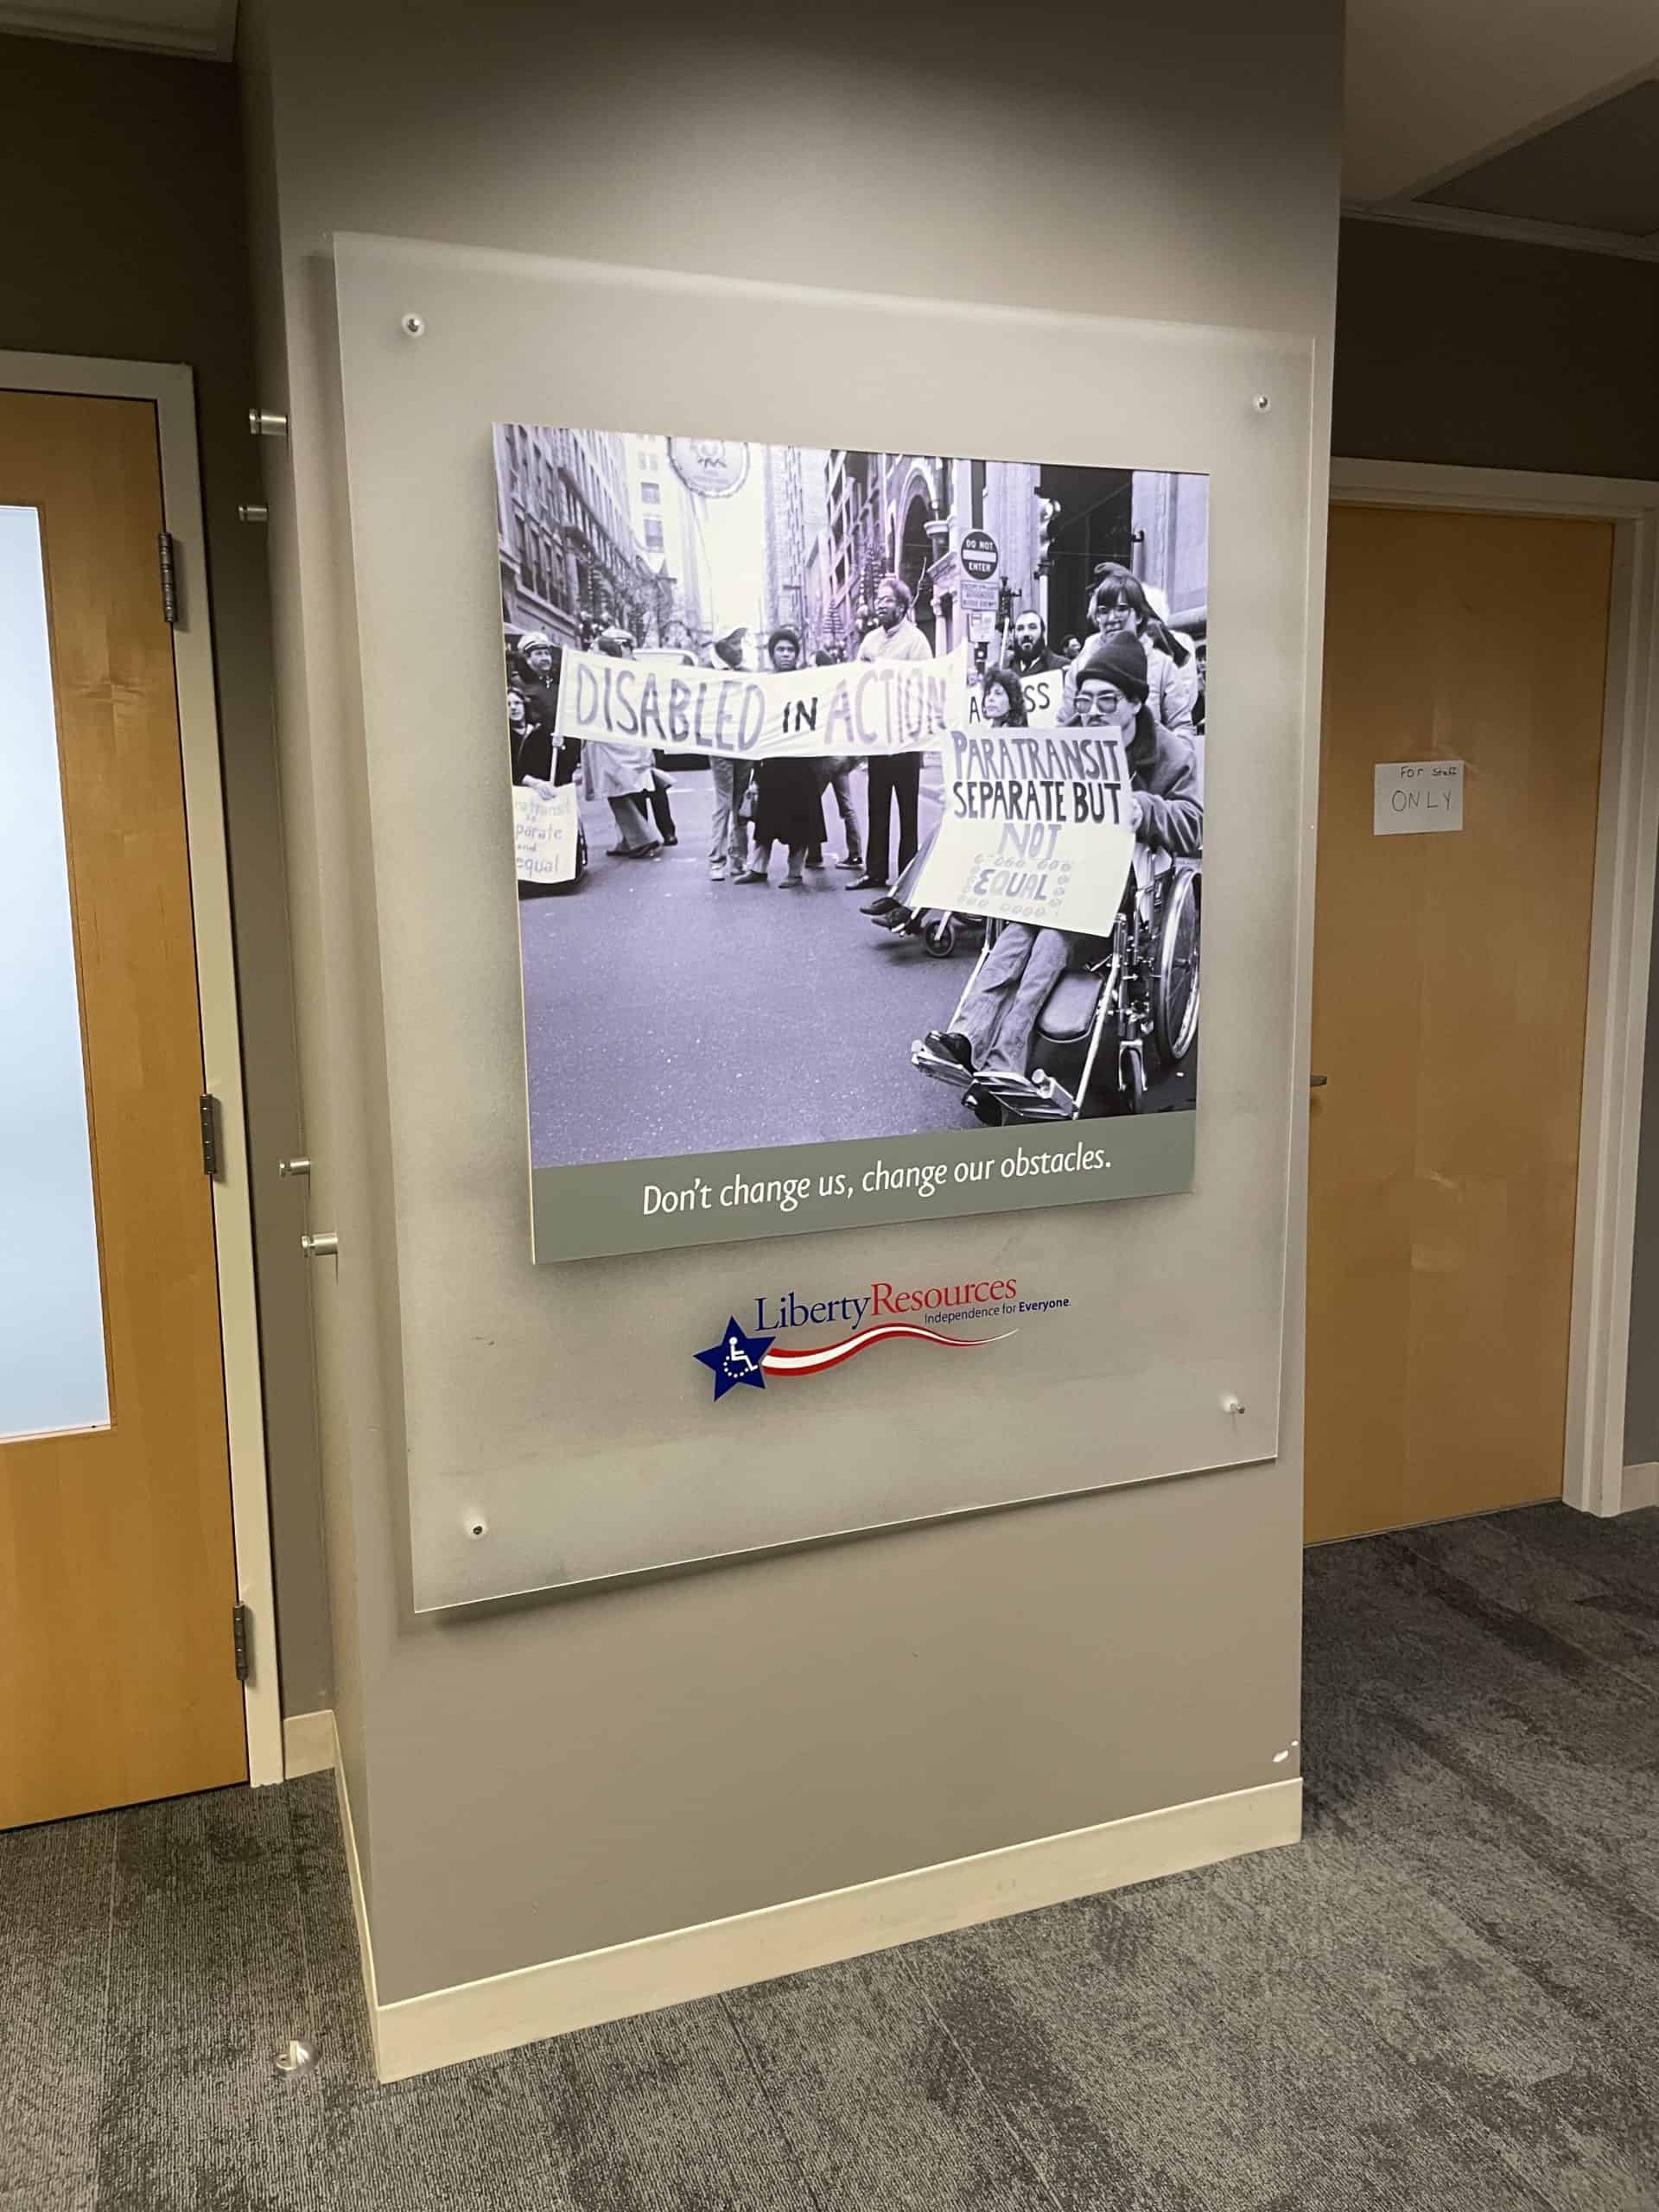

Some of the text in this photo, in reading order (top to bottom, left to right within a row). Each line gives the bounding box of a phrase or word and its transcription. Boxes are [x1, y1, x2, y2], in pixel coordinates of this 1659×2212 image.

[966, 539, 994, 551] DO NOT
[969, 563, 991, 572] ENTER
[576, 664, 948, 752] DISABLED IN ACTION
[950, 730, 1121, 781] PARATRANSIT
[1401, 766, 1424, 779] For
[953, 779, 1121, 824] SEPARATE BUT
[1392, 790, 1452, 811] ONLY
[995, 823, 1062, 860] NOT
[973, 868, 1049, 901] EQUAL
[642, 1141, 1112, 1216] Don't change us, change our obstacles.
[925, 1306, 1000, 1325] Independence
[1002, 1303, 1017, 1314] for
